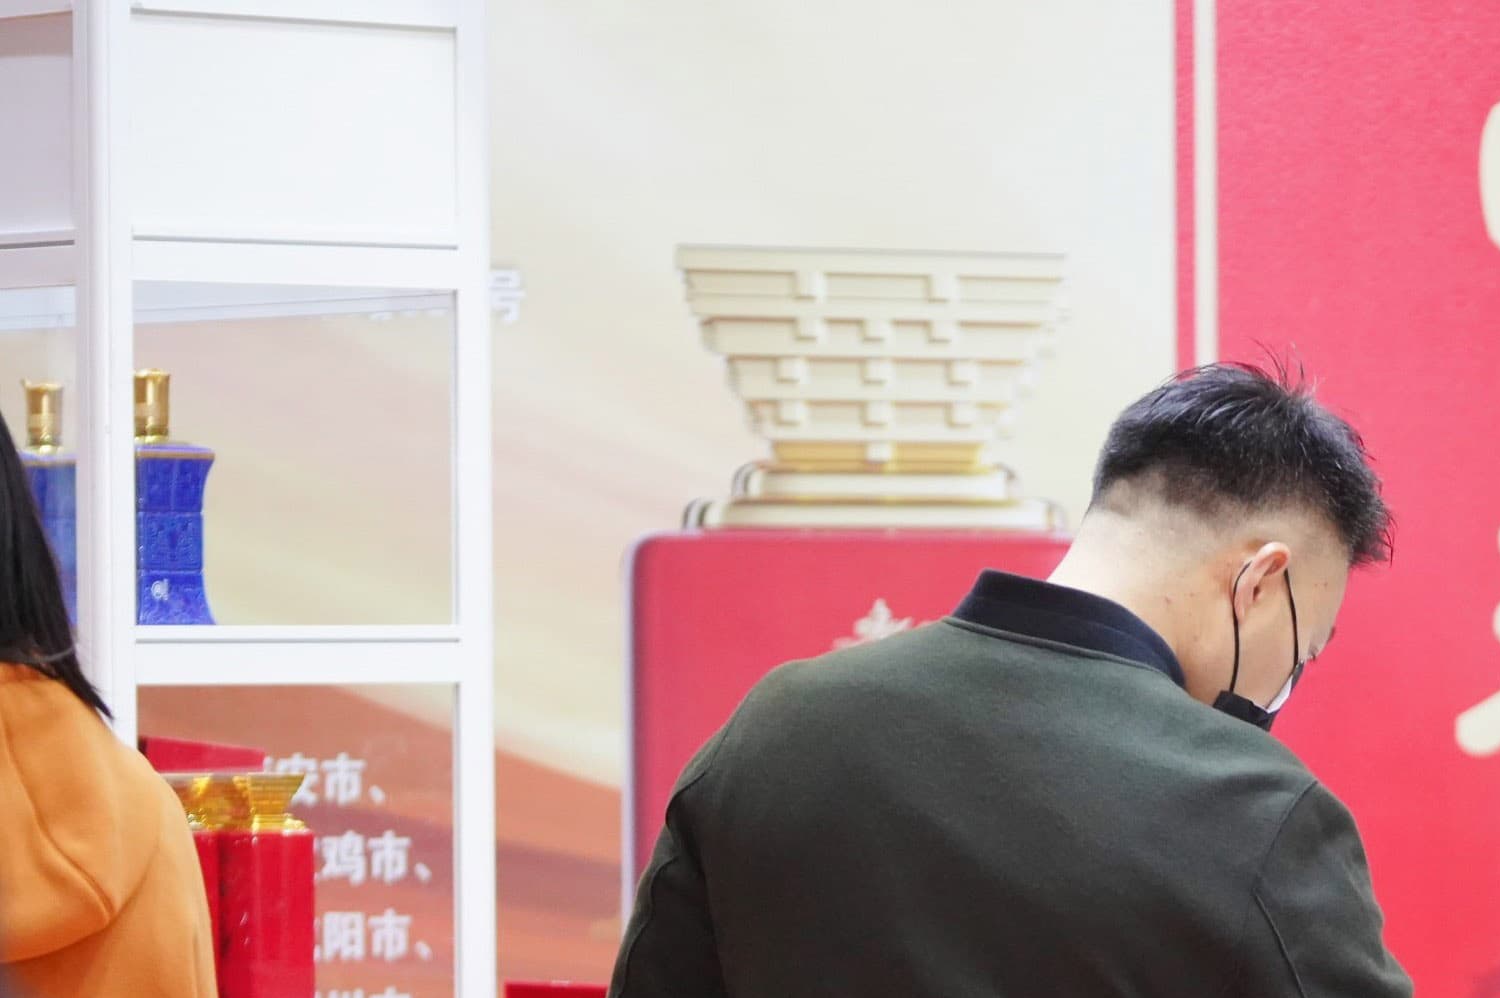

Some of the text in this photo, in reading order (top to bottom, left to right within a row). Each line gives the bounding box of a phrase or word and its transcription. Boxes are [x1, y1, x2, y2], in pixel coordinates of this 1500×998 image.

[263, 752, 386, 806] 安市、
[314, 829, 432, 884] 鸡市、
[314, 907, 433, 962] 阳市、
